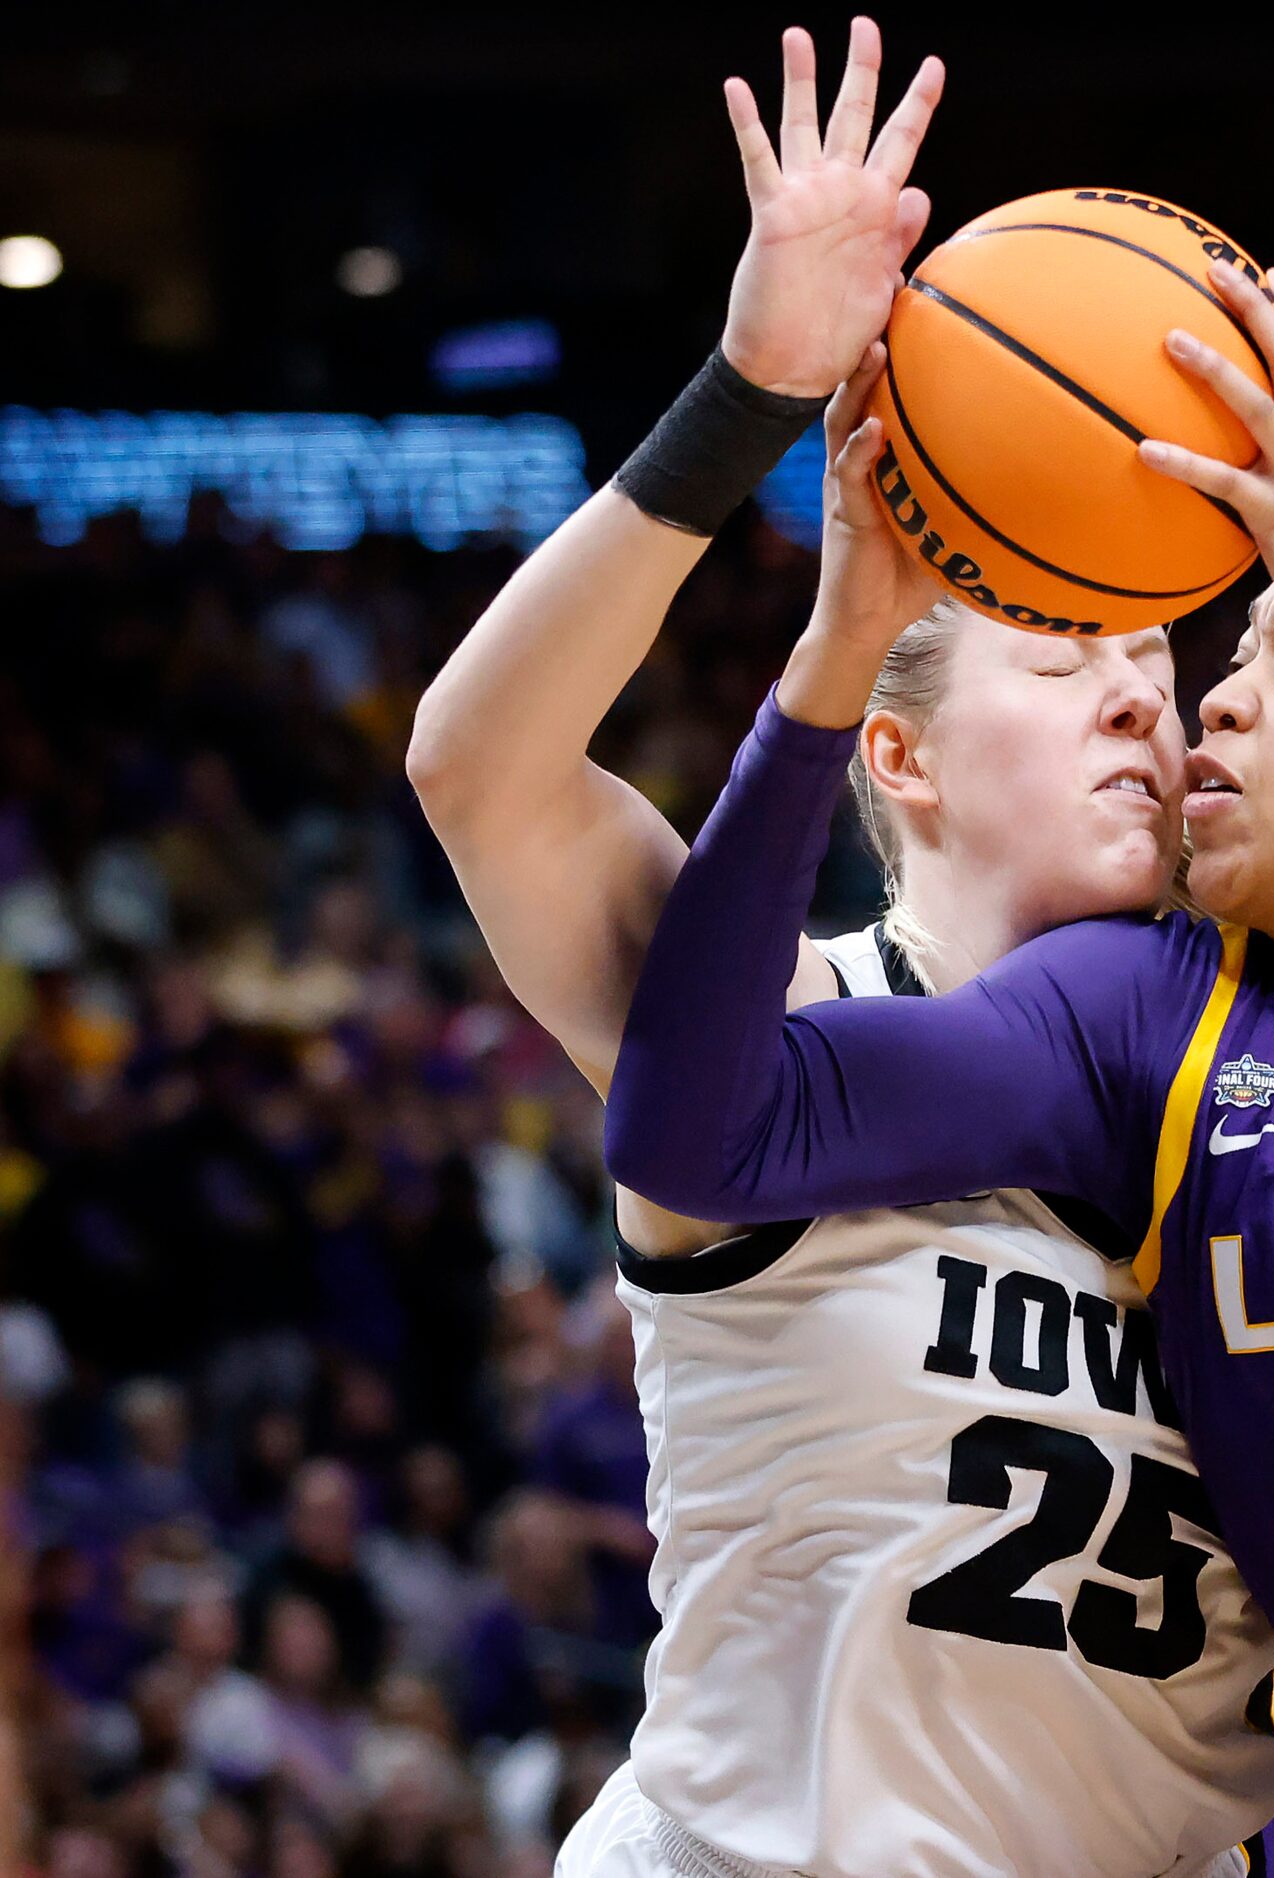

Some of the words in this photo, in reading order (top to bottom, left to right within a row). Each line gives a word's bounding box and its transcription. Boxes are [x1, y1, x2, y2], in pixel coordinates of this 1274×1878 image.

[876, 439, 1103, 635] Wilson
[1215, 1073, 1244, 1086] INAL
[924, 1255, 1184, 1435] IOW
[906, 1414, 1226, 1681] 25
